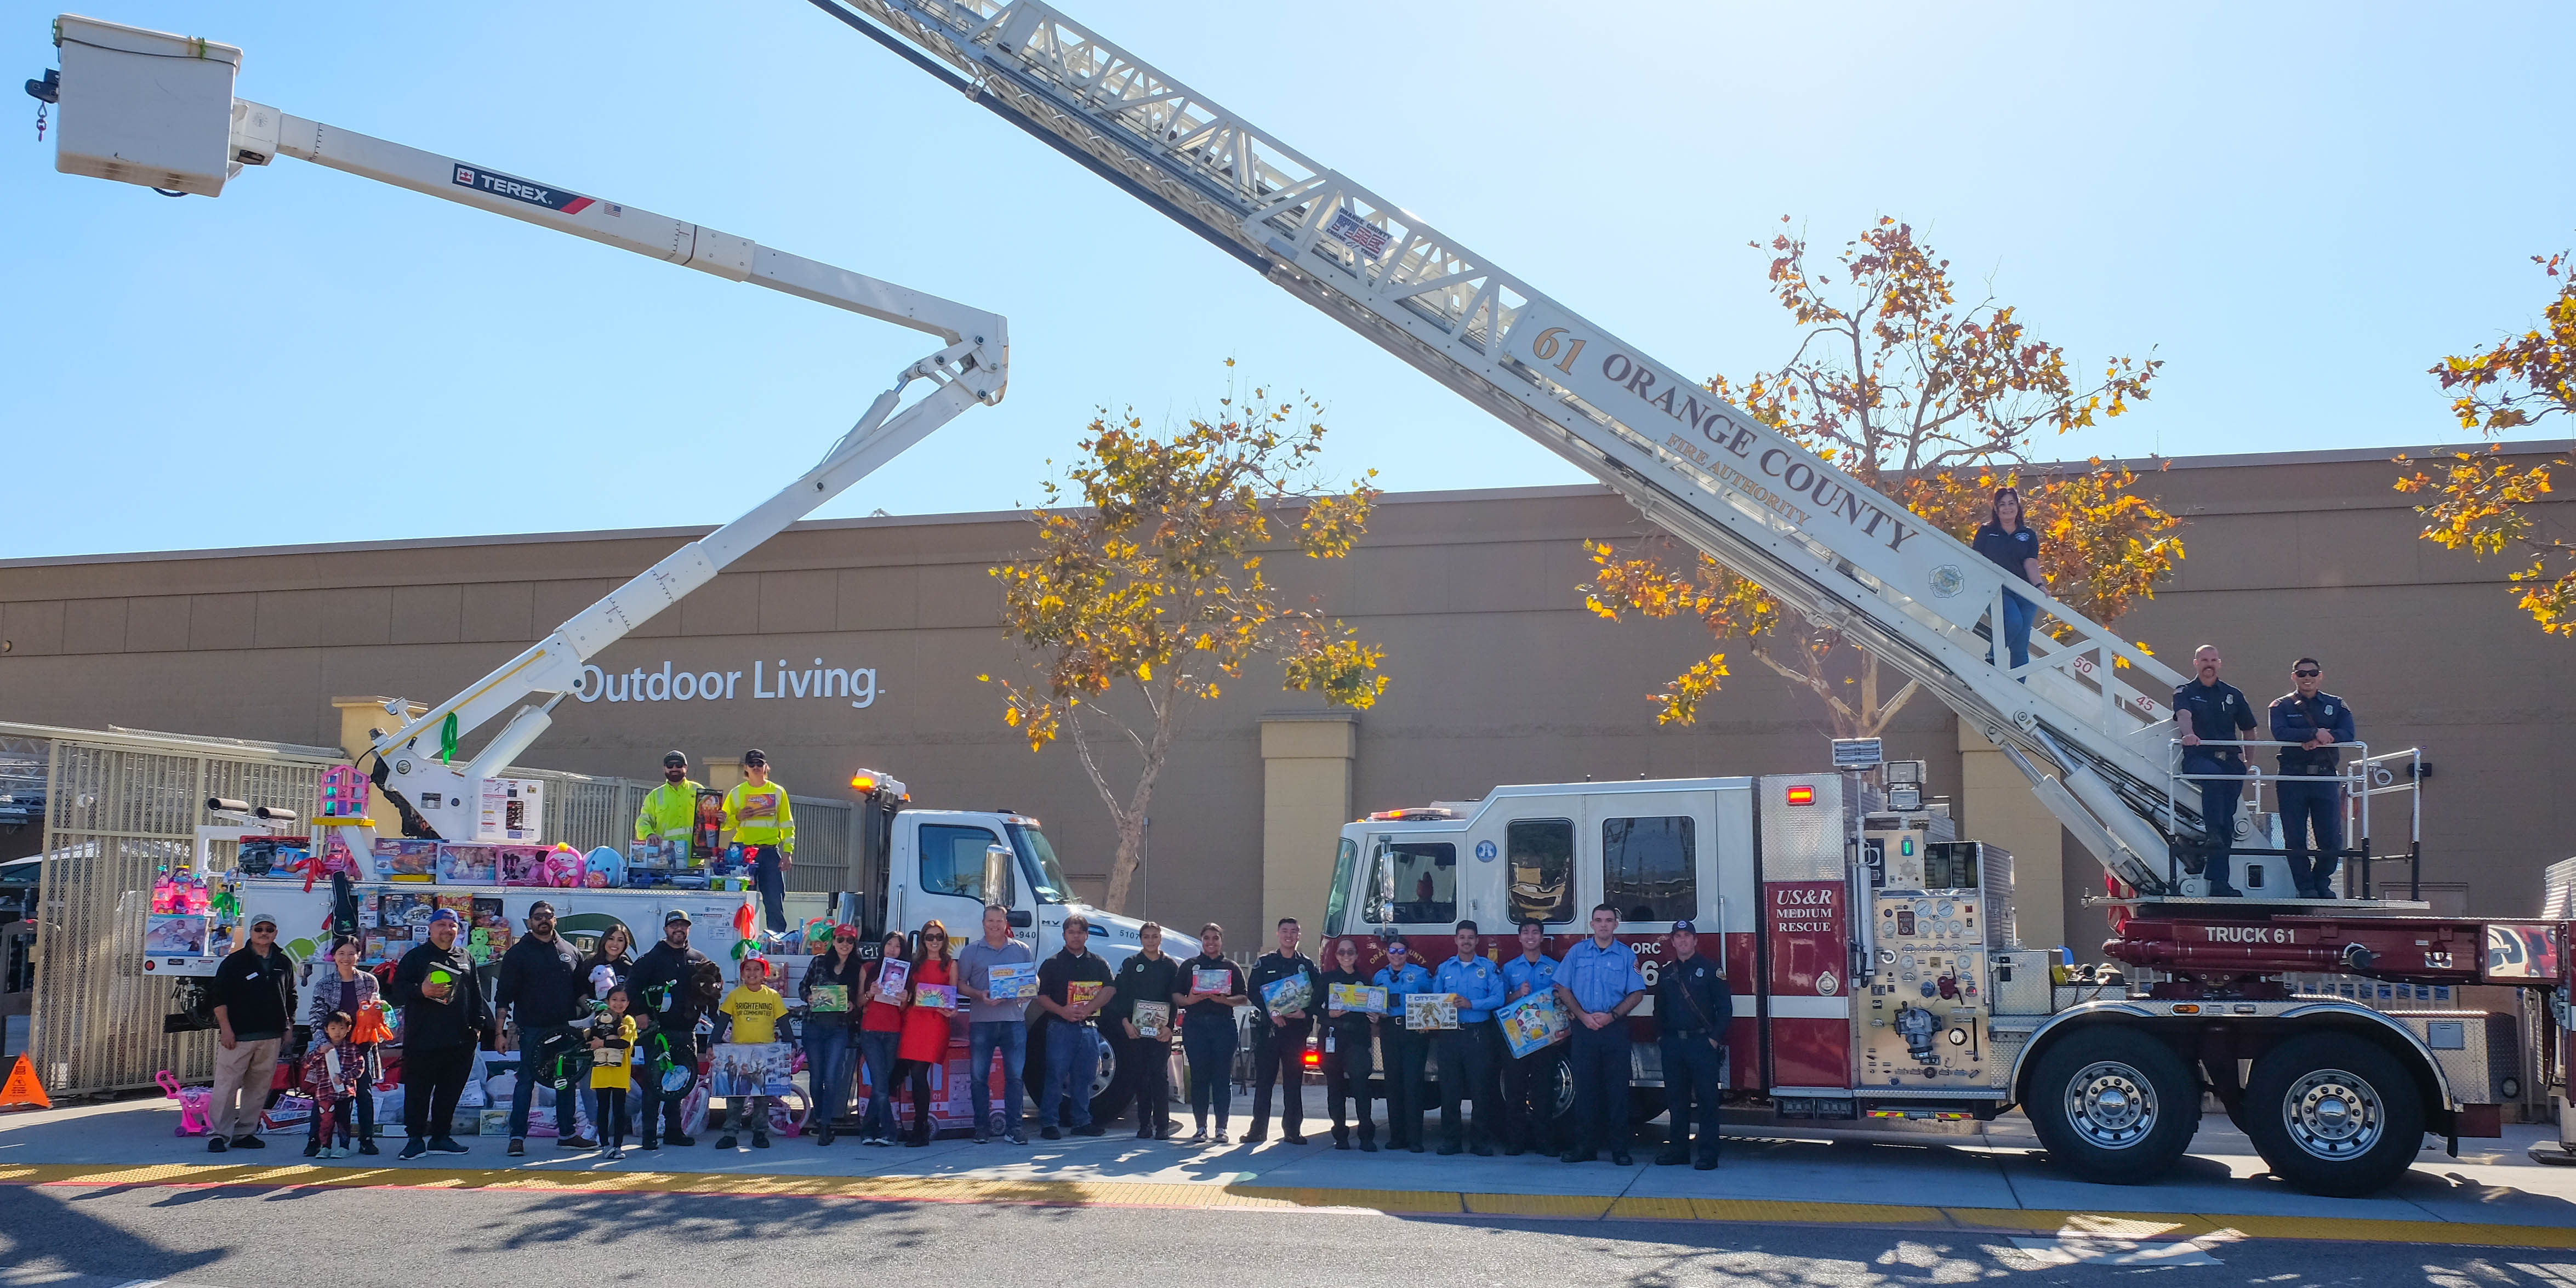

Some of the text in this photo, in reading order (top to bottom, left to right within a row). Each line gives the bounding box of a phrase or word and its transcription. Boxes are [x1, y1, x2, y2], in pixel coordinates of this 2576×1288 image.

[1339, 208, 1393, 240] ORANGE COUNTY
[1326, 228, 1346, 242] ENGINE
[1360, 248, 1379, 261] TRUCK
[1533, 327, 1586, 376] 61
[1602, 354, 1919, 552] ORANGE COUNTY
[1666, 432, 1811, 527] FIRE AUTHORITY
[2073, 657, 2092, 673] 50
[2136, 697, 2155, 711] 45
[1777, 890, 1832, 905] US&R
[1776, 908, 1832, 918] MEDIUM
[1779, 922, 1831, 932] RESCUE
[2205, 927, 2295, 943] TRUCK 61
[1631, 942, 1661, 954] ORC
[1370, 949, 1427, 964] ORAN UNTY
